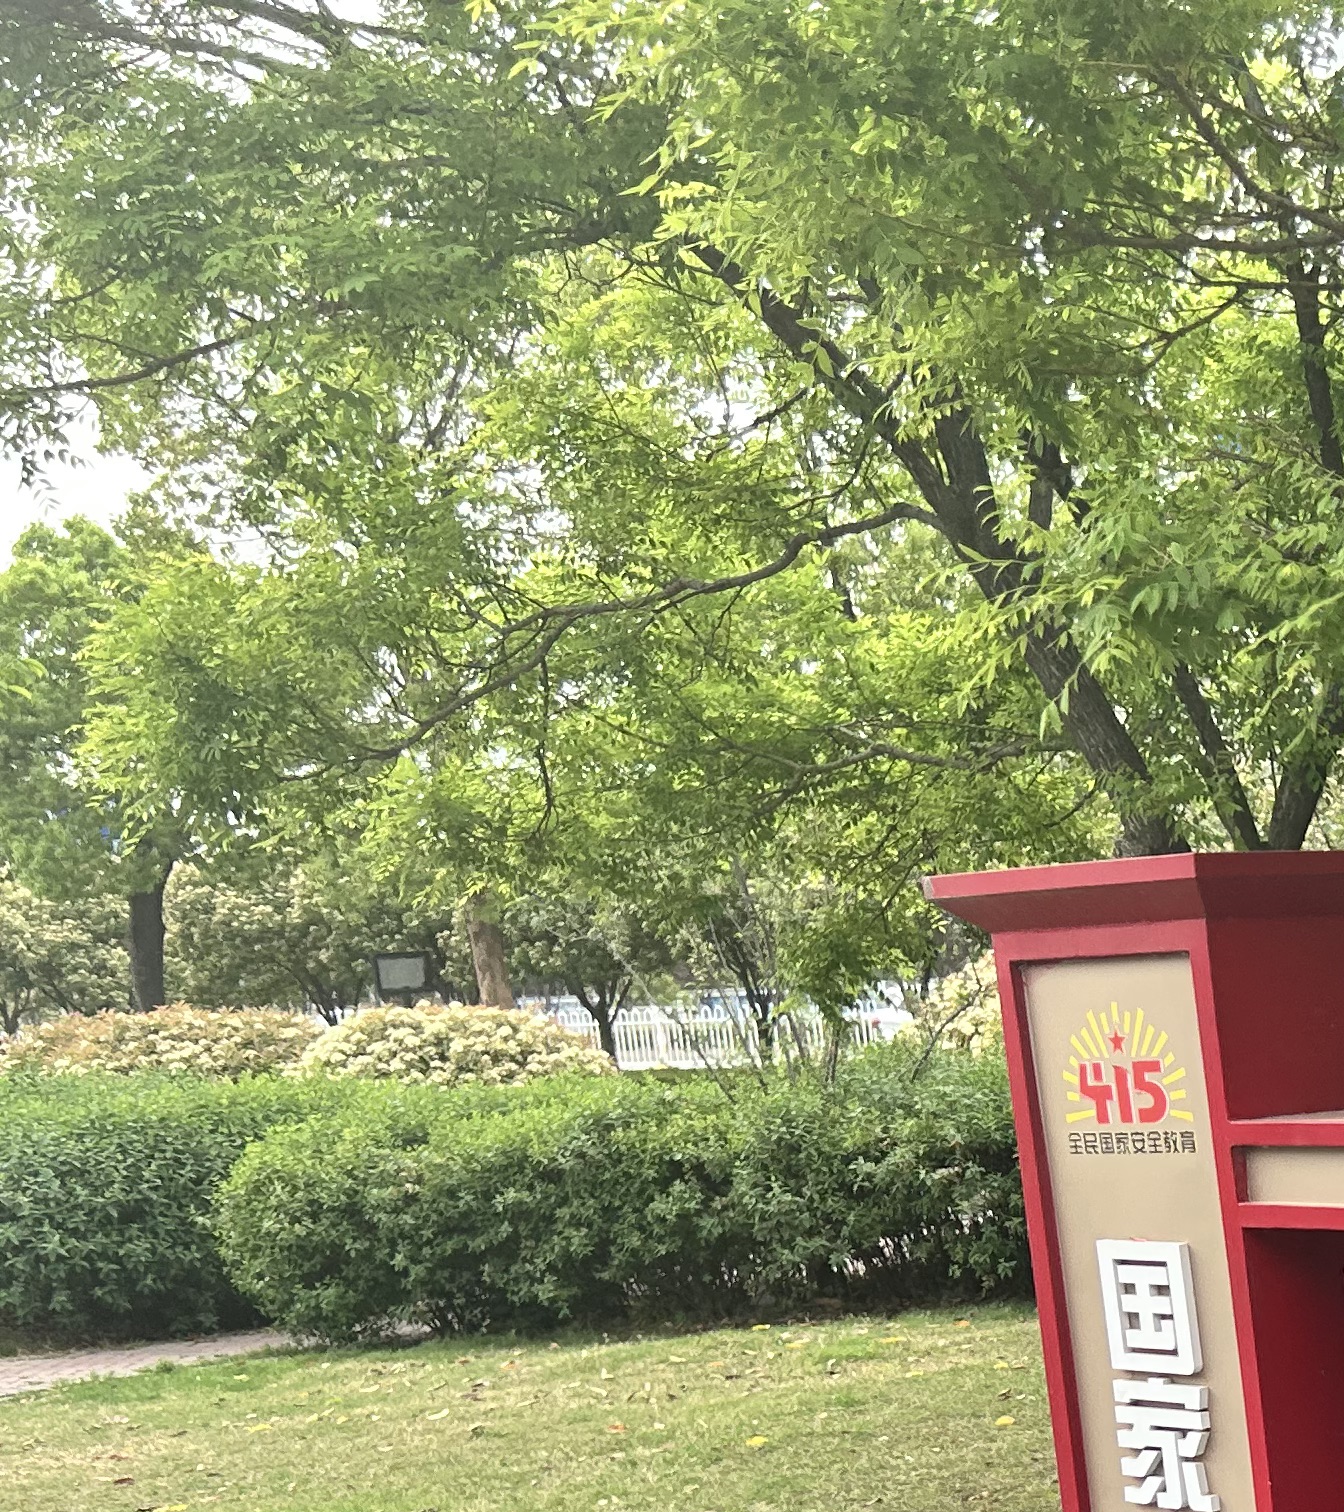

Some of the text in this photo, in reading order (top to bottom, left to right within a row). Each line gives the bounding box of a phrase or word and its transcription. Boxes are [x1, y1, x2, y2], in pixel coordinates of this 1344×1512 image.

[1079, 1060, 1169, 1124] 415
[1069, 1131, 1196, 1154] 全民国家安全教育
